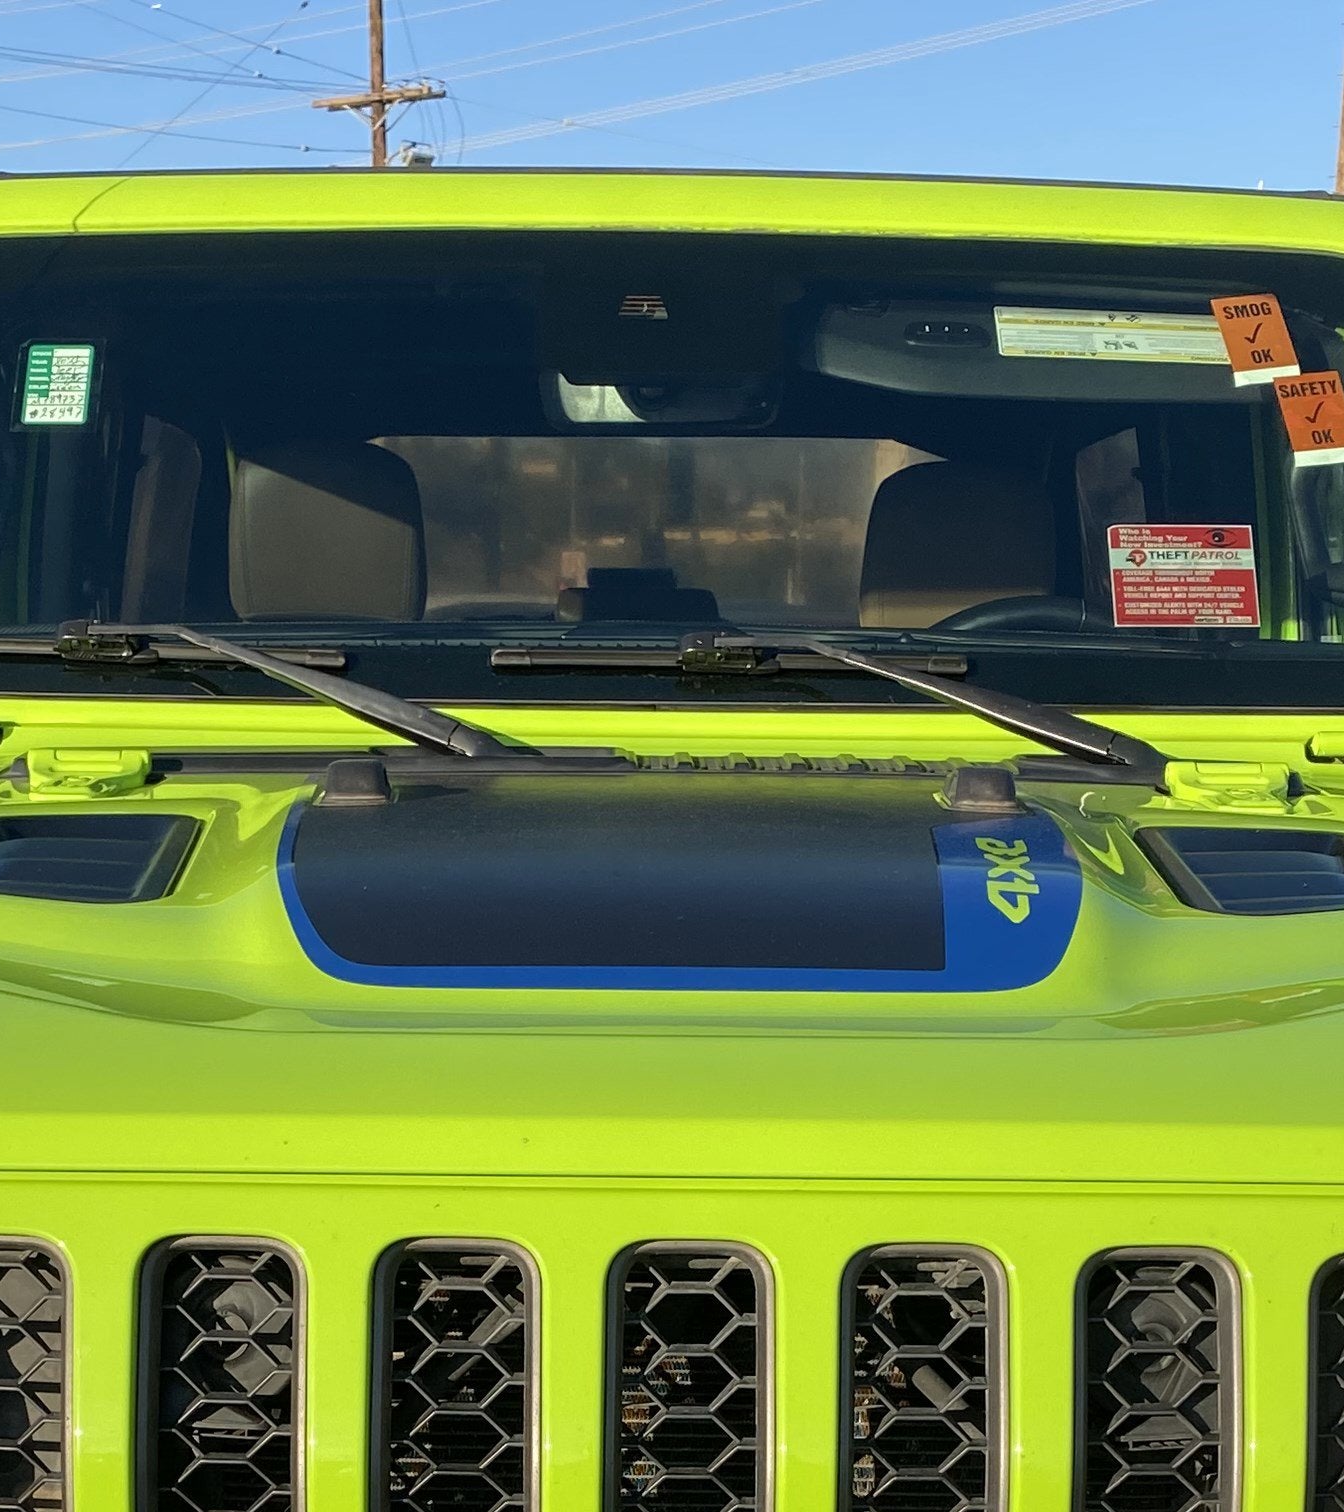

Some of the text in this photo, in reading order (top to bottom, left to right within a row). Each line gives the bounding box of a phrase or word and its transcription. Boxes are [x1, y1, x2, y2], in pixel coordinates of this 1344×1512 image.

[1223, 301, 1272, 320] SMOG
[1250, 348, 1274, 364] OK
[1278, 379, 1338, 399] SAFETY
[1311, 429, 1335, 445] OK
